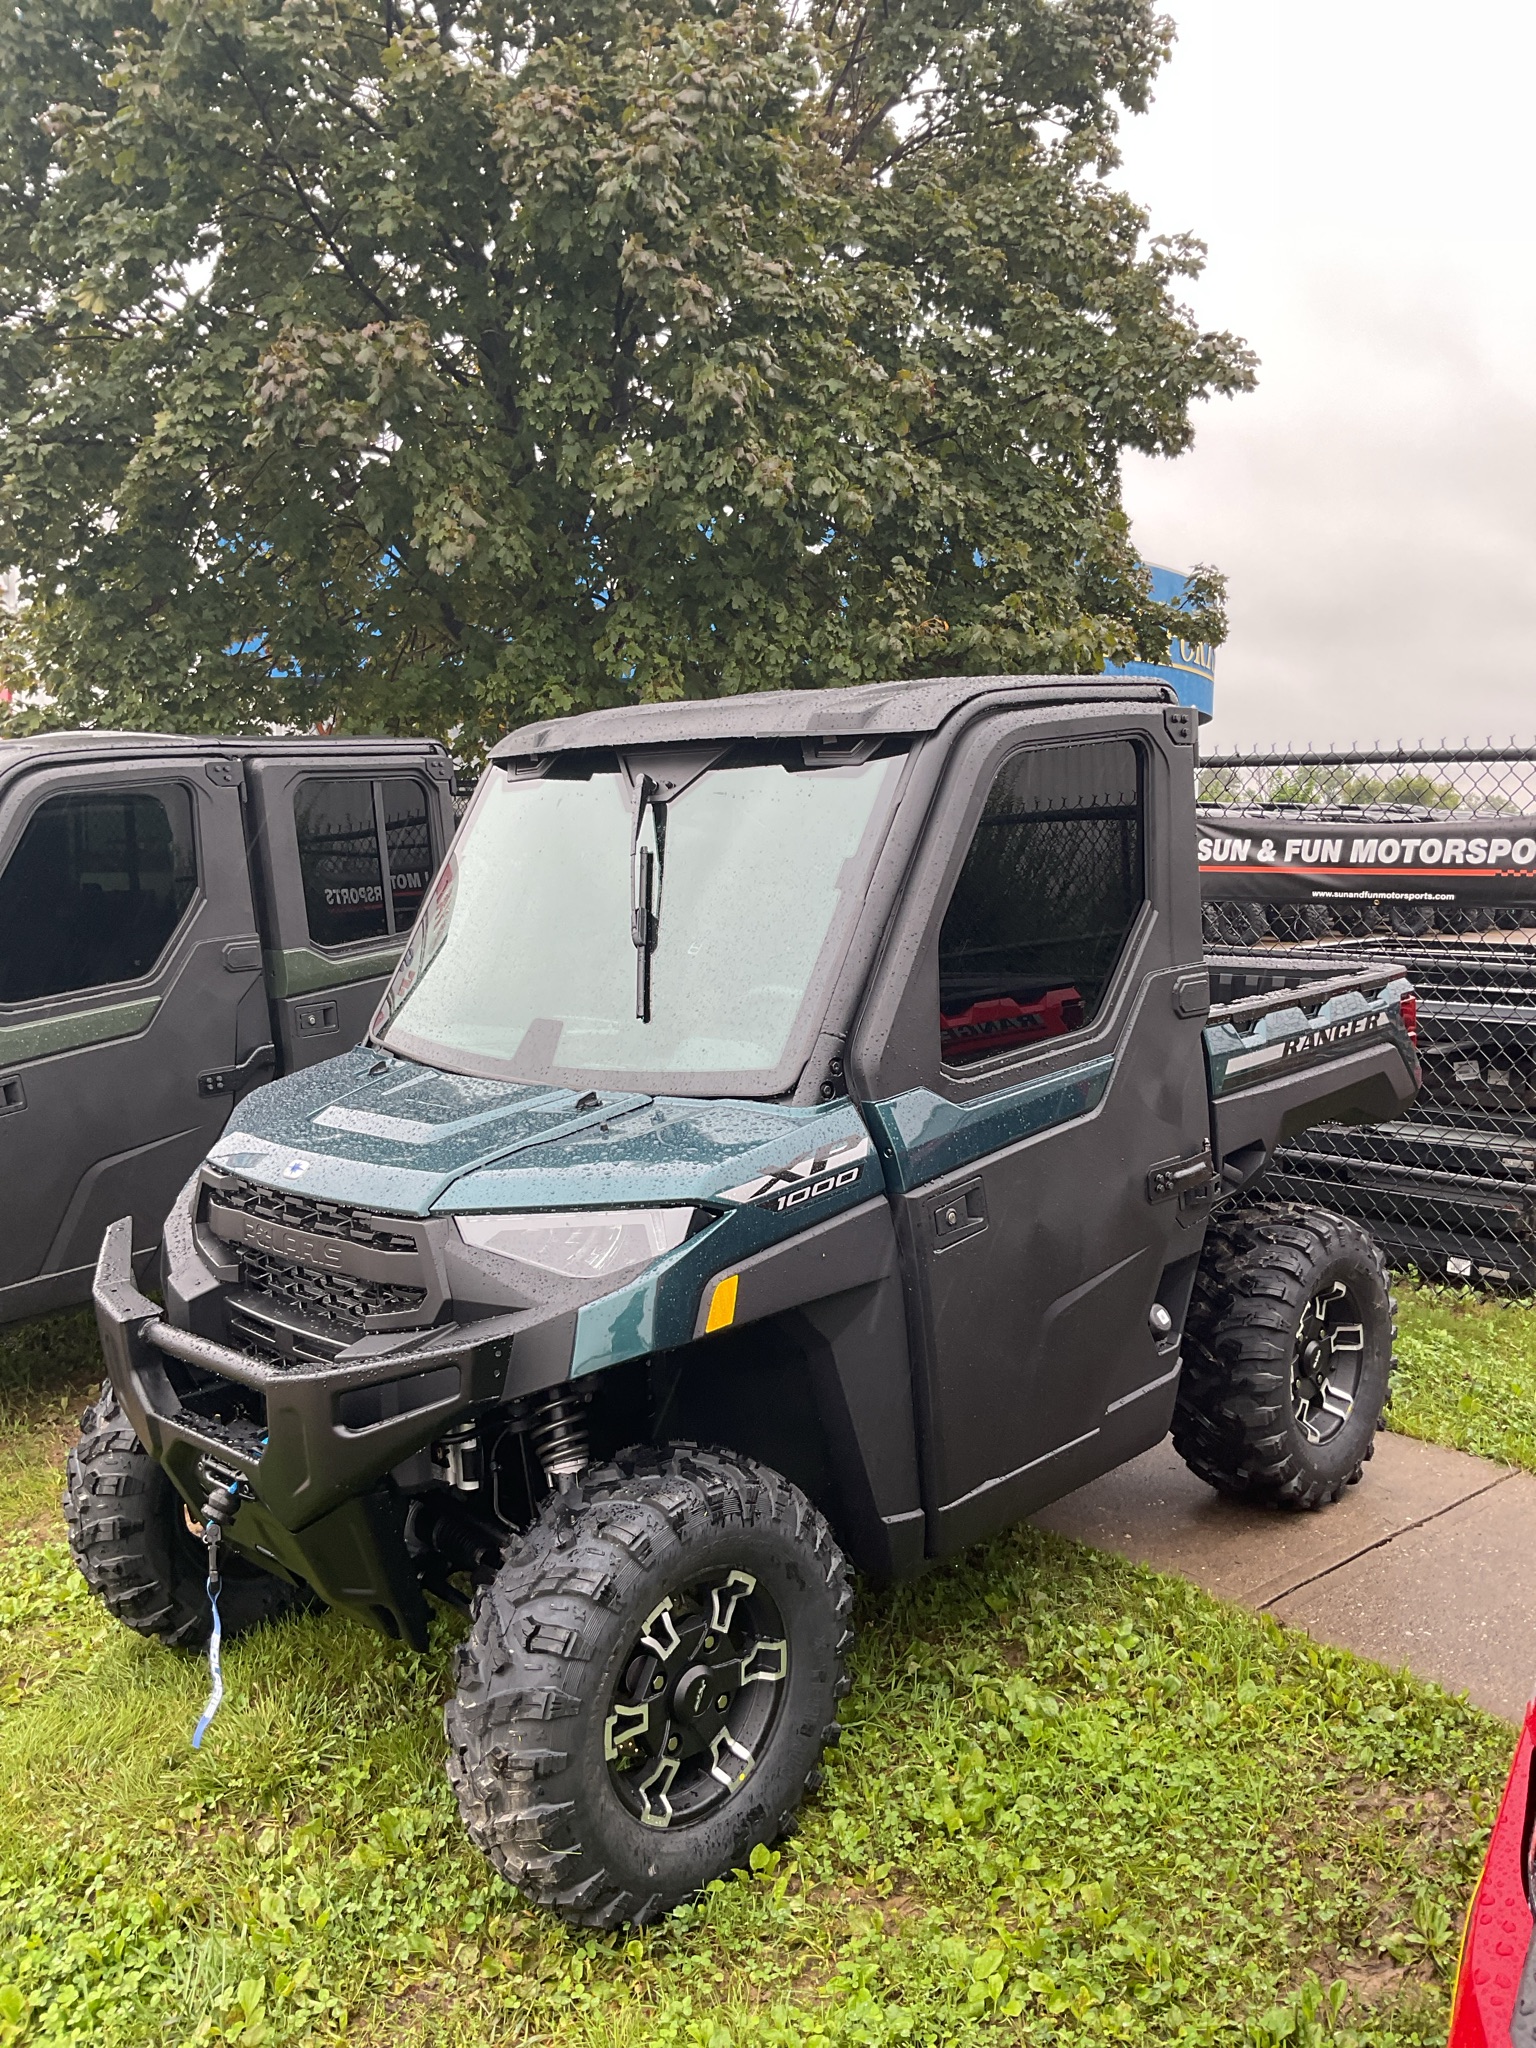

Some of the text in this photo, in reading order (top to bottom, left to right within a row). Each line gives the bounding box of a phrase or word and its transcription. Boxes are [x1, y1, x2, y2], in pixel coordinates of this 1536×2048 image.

[1198, 838, 1536, 864] SUN & FUN MOTORSPO
[1312, 890, 1455, 901] www.sunandfunmotorsports.com
[1282, 1012, 1381, 1057] RANGER
[748, 1133, 862, 1200] XP
[777, 1167, 859, 1211] 1000
[243, 1219, 342, 1268] POLARIS
